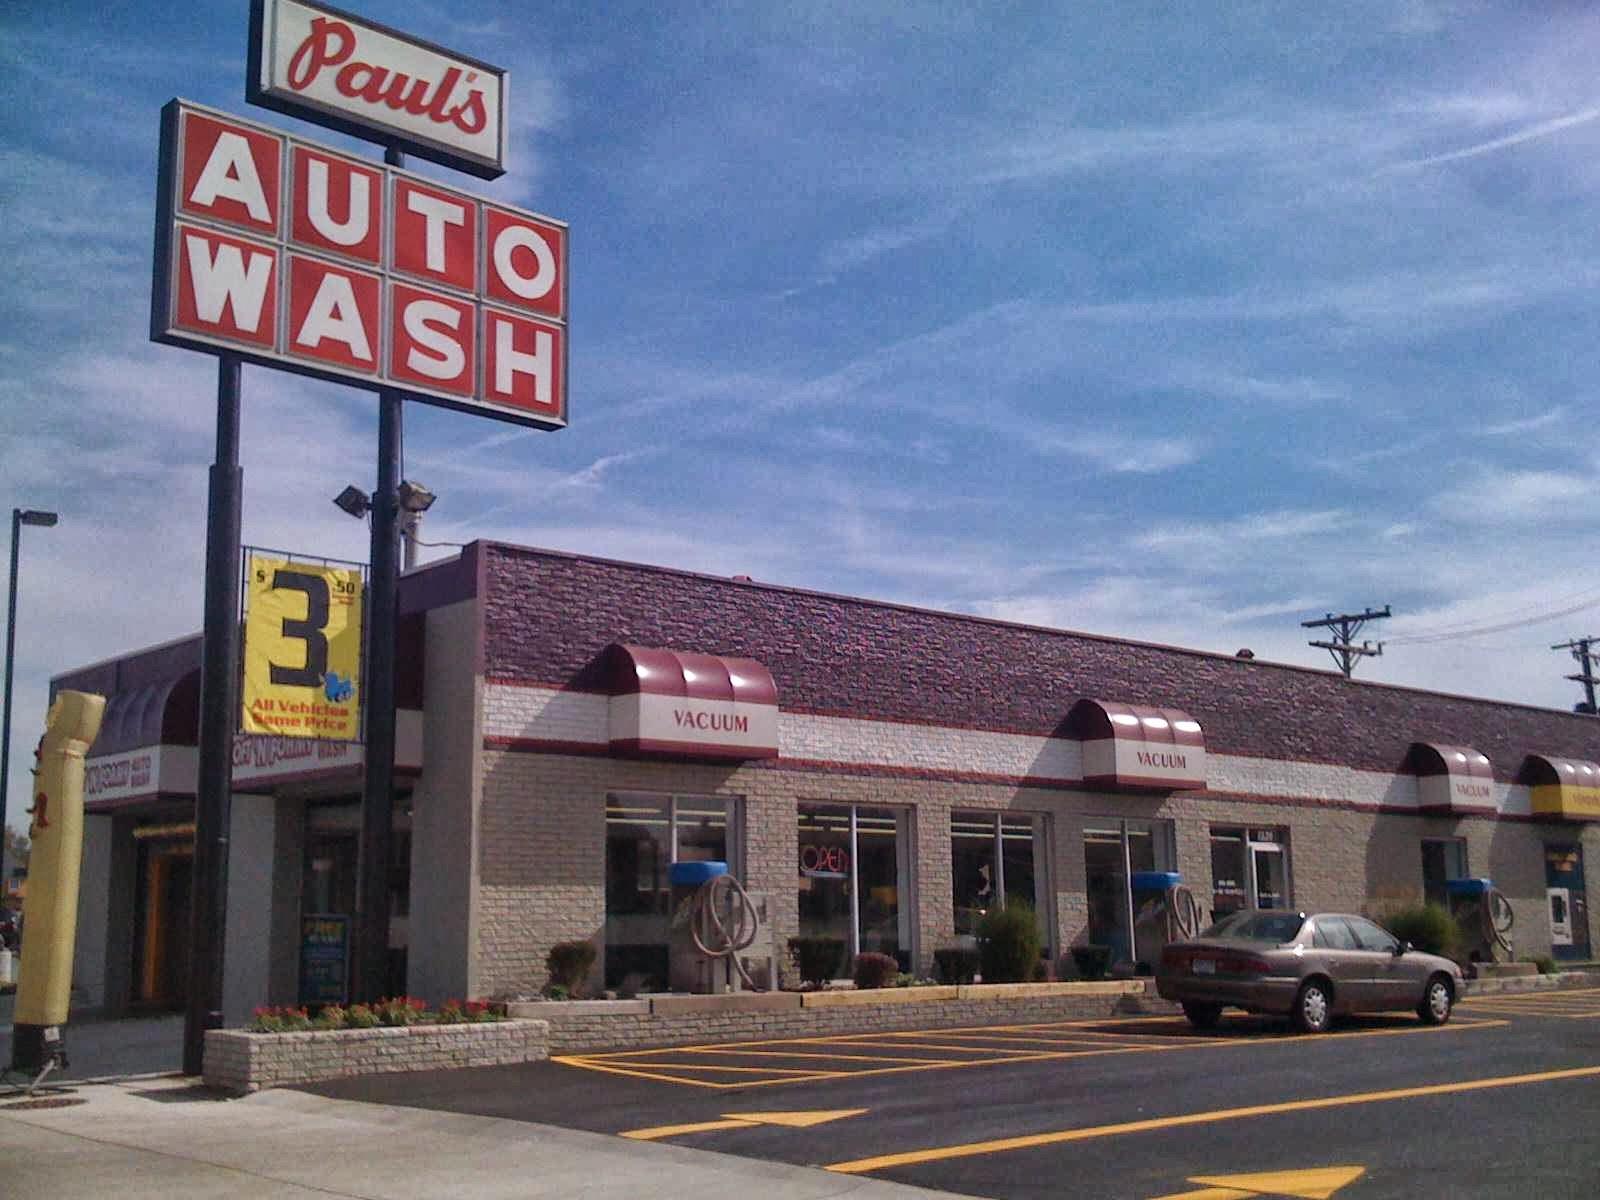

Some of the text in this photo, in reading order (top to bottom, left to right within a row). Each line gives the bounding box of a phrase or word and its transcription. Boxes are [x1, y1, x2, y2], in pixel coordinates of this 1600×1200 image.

[287, 17, 487, 135] Paul's
[190, 131, 556, 299] AUTO
[185, 234, 553, 404] WASH
[253, 698, 349, 717] All Vehicles
[304, 716, 347, 731] Price
[674, 709, 748, 733] VACUUM
[1136, 751, 1186, 769] VACUUM
[800, 846, 849, 872] OPEN
